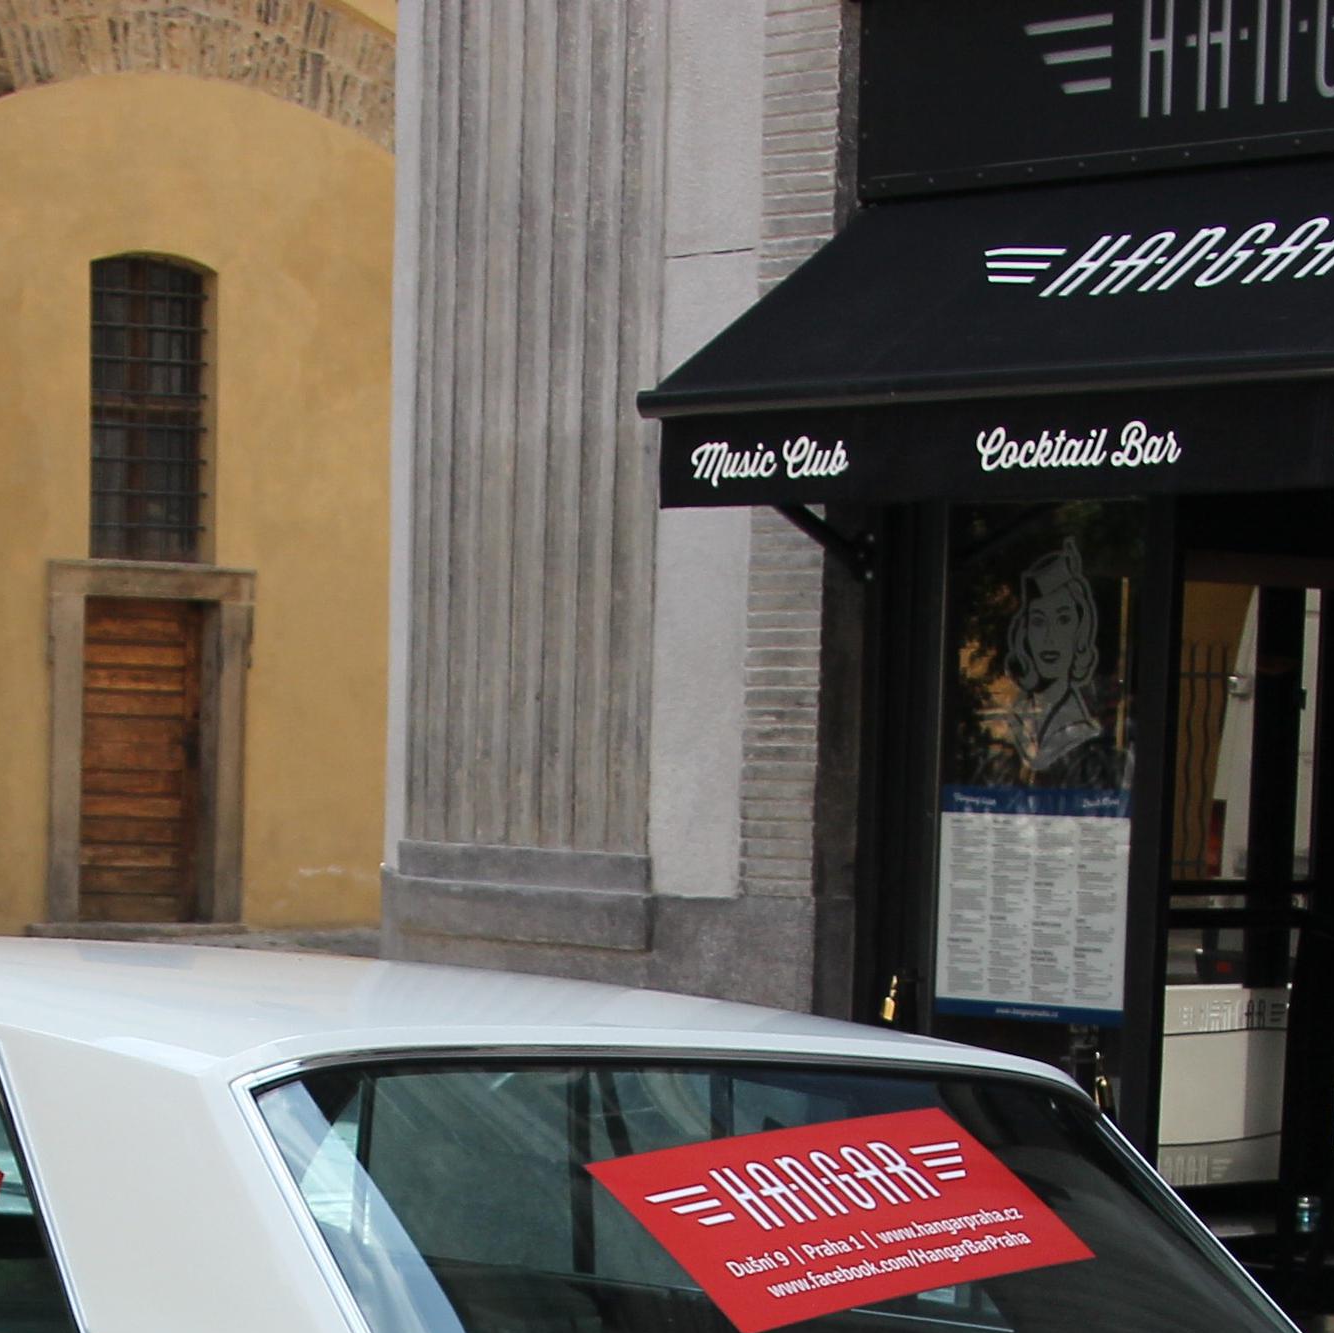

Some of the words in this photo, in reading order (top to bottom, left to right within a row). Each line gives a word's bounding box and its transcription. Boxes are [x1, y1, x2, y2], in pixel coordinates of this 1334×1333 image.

[691, 441, 777, 487] Music
[783, 435, 849, 479] Club
[976, 426, 1108, 471] Cocktail
[1111, 420, 1183, 467] Bar
[708, 1140, 942, 1231] HANGAR
[725, 1252, 778, 1278] Dušní
[774, 1251, 791, 1267] 9
[801, 1239, 851, 1260] Praha
[849, 1236, 866, 1251] 1
[876, 1207, 1024, 1244] www.hangarpraha.cz
[766, 1231, 1032, 1298] www.facebook.com/HangarBarPraha
